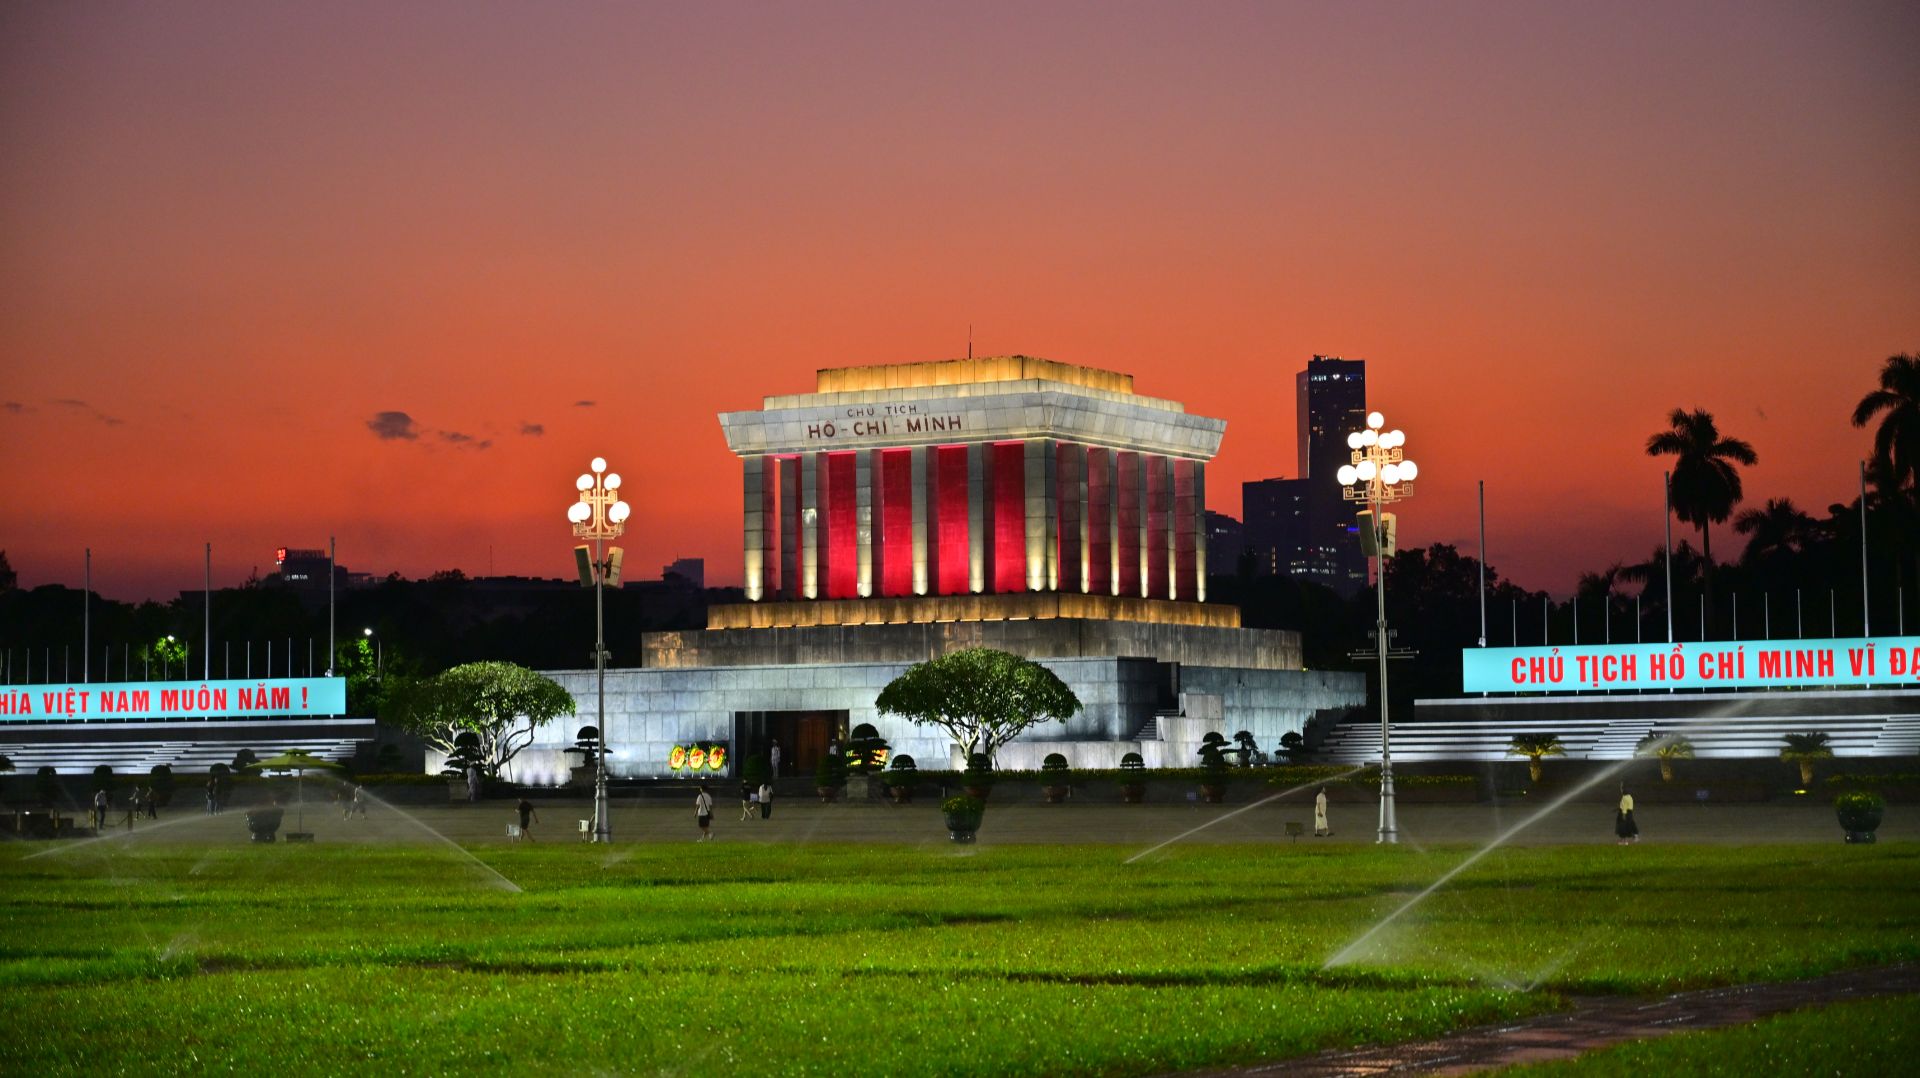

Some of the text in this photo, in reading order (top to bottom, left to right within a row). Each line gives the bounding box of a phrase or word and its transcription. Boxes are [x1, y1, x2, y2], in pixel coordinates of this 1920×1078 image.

[1512, 647, 1564, 684] CHỦ
[1575, 654, 1637, 687] TỊCH
[1649, 643, 1686, 680] HỒ
[1698, 646, 1745, 680] CHÍ
[1758, 649, 1835, 679] MINH
[1848, 643, 1876, 677] VĨ
[43, 687, 90, 718] VIỆT
[100, 690, 150, 713] NAM
[160, 684, 227, 712] MUÔN
[238, 682, 290, 711] NĂM
